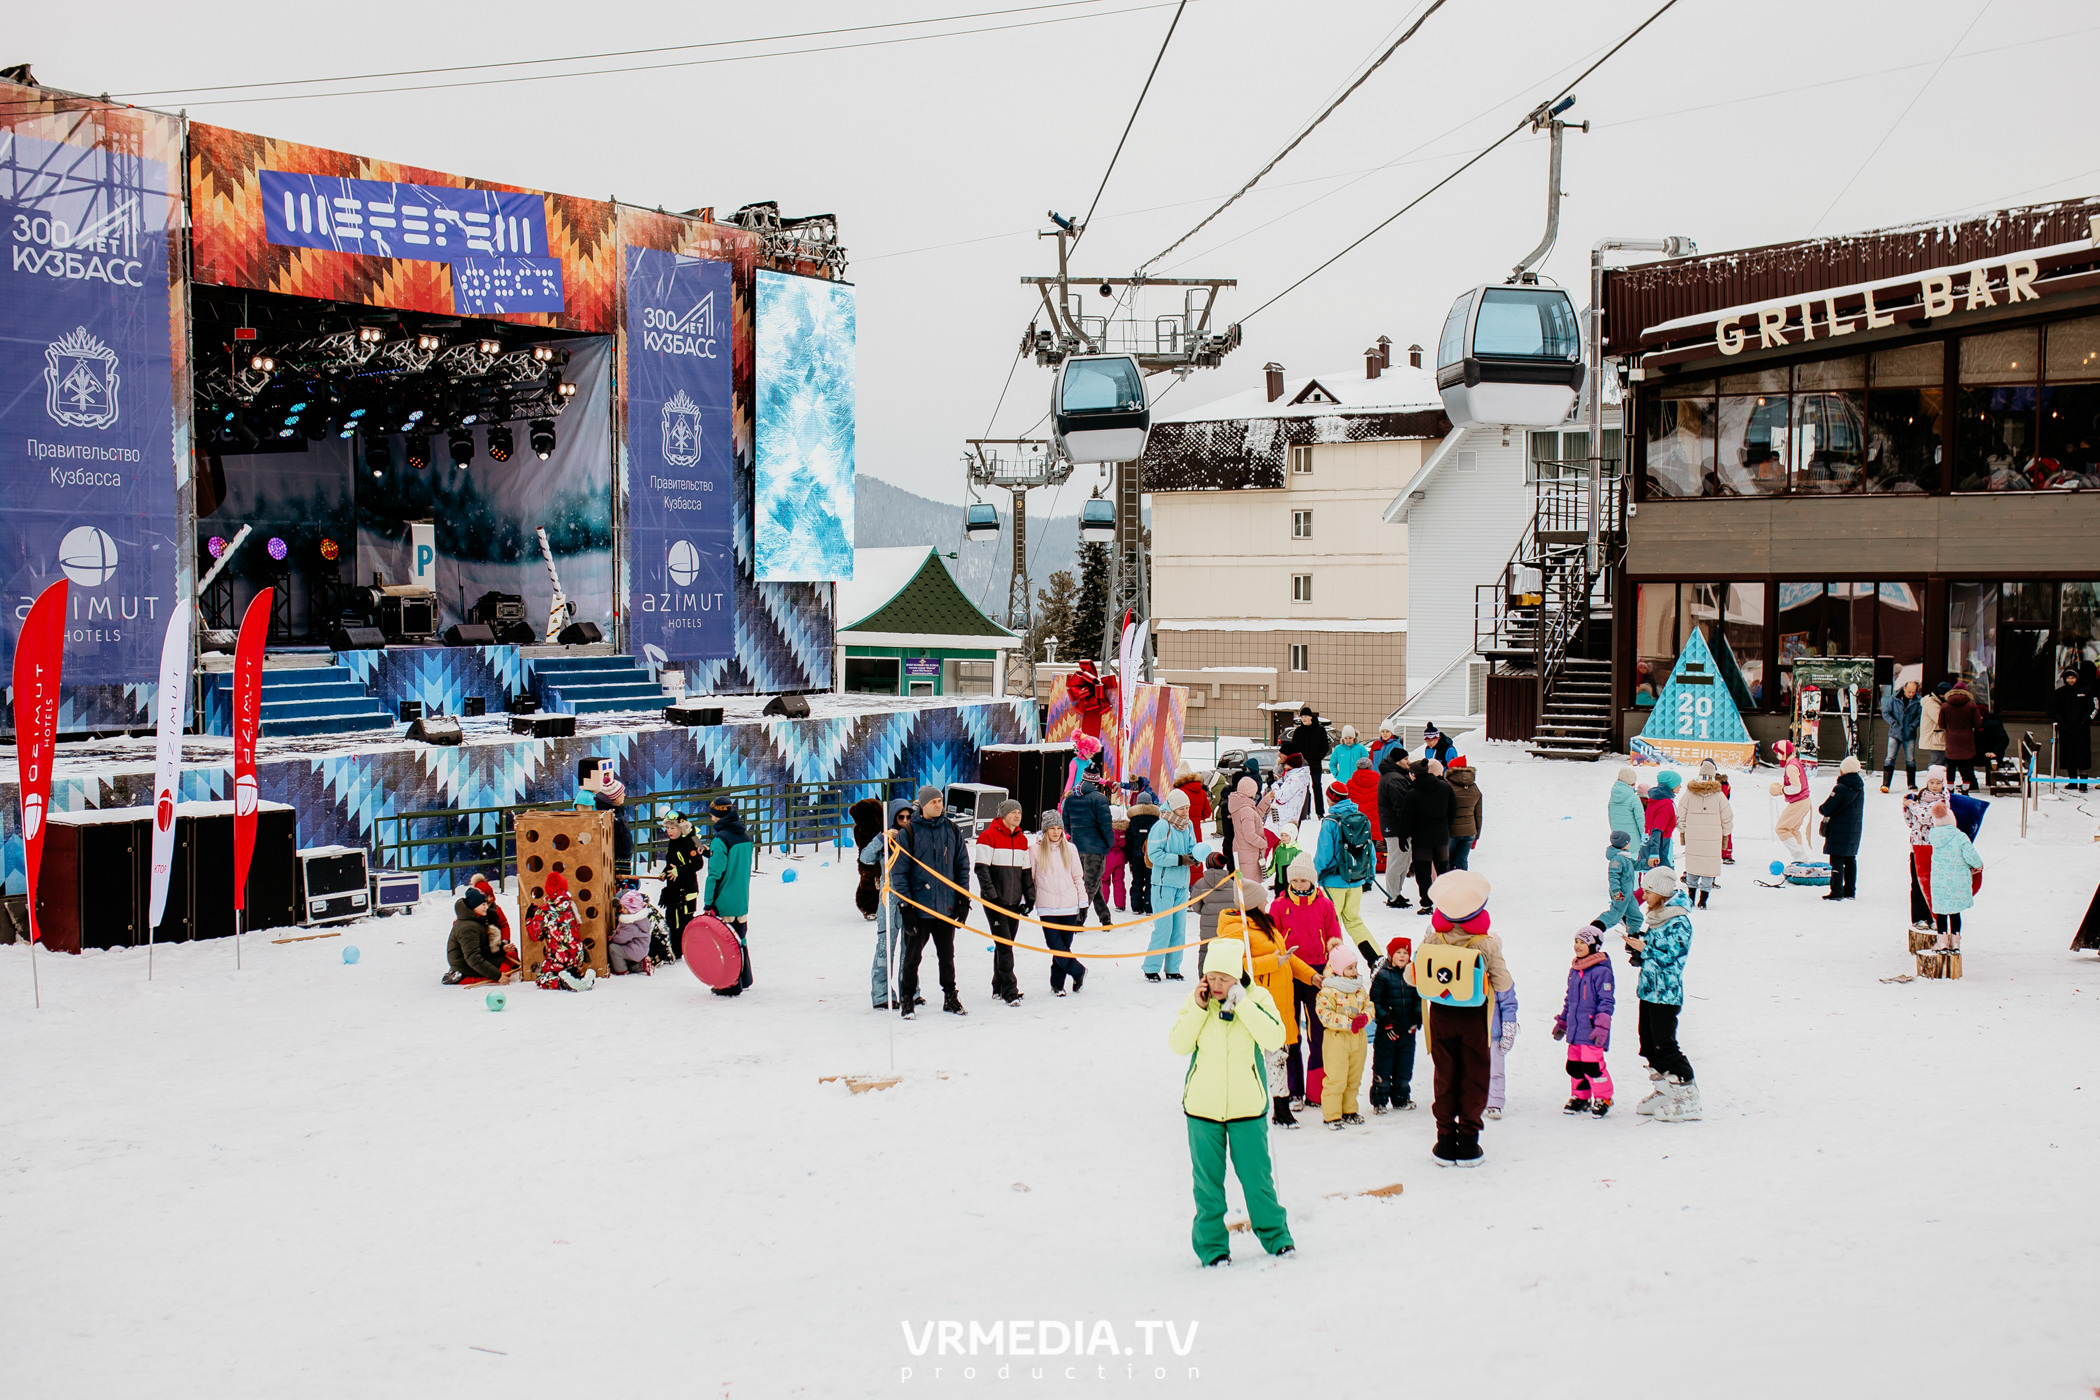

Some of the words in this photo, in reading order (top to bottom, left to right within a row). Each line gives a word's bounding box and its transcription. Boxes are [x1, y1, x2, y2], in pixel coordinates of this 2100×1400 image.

[12, 213, 70, 249] 300
[12, 244, 144, 288] КУЗБАСС
[643, 307, 677, 332] 300
[1716, 290, 1896, 356] GRILL
[1920, 259, 2041, 320] BAR
[643, 330, 717, 359] КУЗБАСС
[1127, 400, 1143, 411] 34
[27, 438, 141, 463] Правительство
[50, 466, 121, 488] Кузбасса
[650, 475, 714, 492] Правительство
[664, 496, 702, 512] Кузбасса
[1016, 500, 1023, 509] 9
[15, 596, 159, 621] aIMUT
[668, 618, 702, 629] HOTELS
[43, 698, 53, 748] HOTELS
